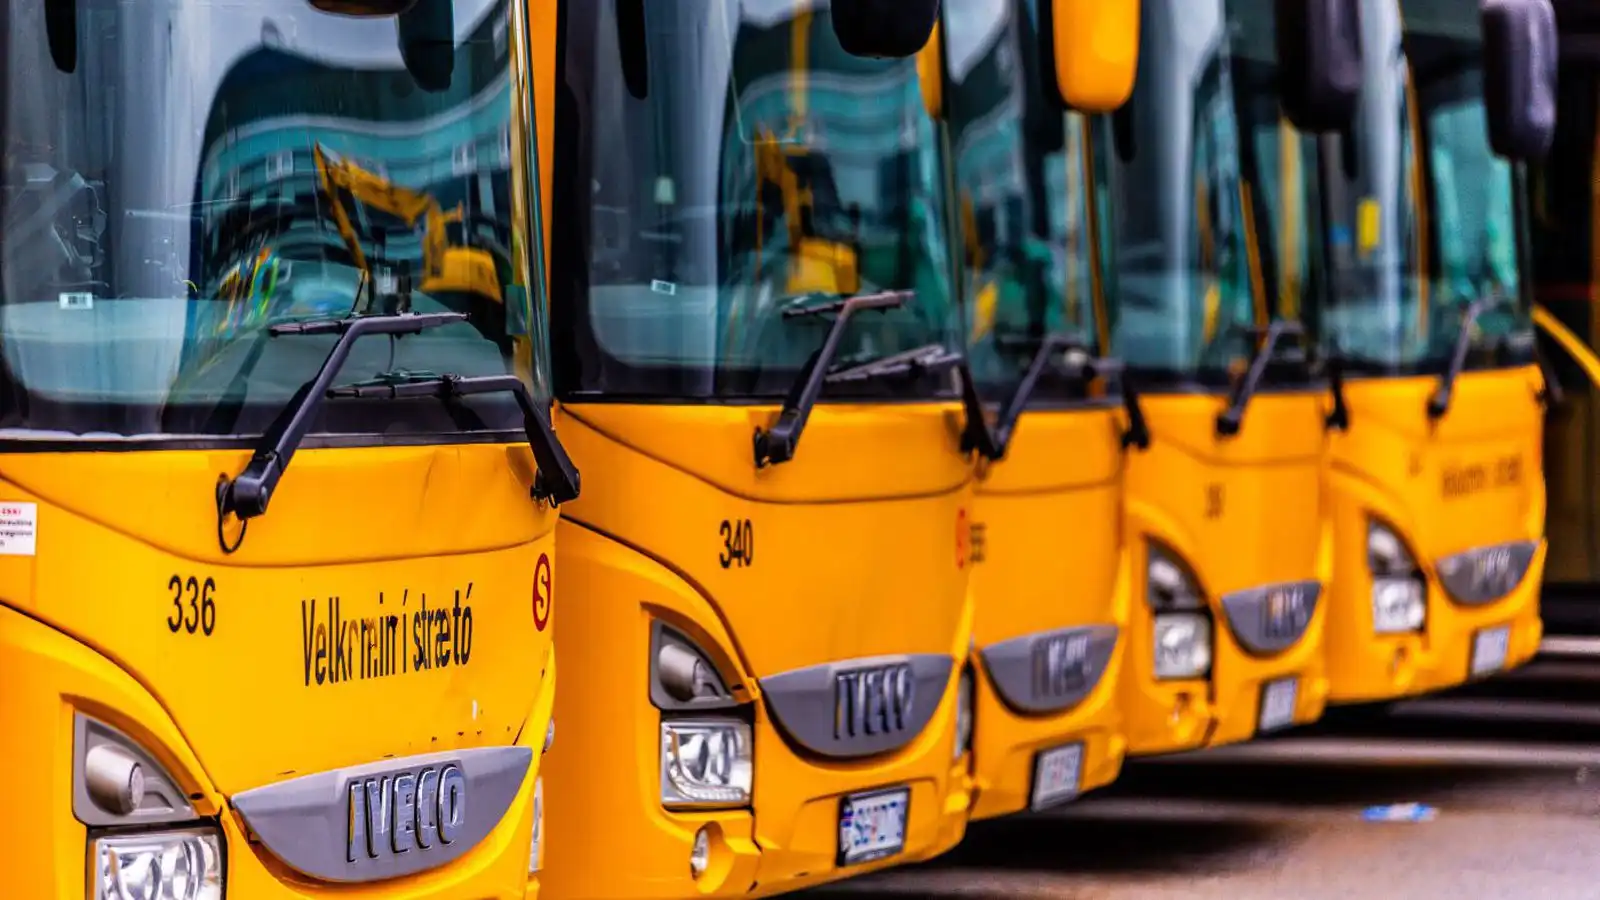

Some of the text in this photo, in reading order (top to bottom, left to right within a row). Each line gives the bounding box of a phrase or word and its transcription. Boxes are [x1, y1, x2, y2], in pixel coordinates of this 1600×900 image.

[718, 519, 754, 570] 340
[167, 574, 217, 637] 336
[347, 763, 466, 863] IVECO
